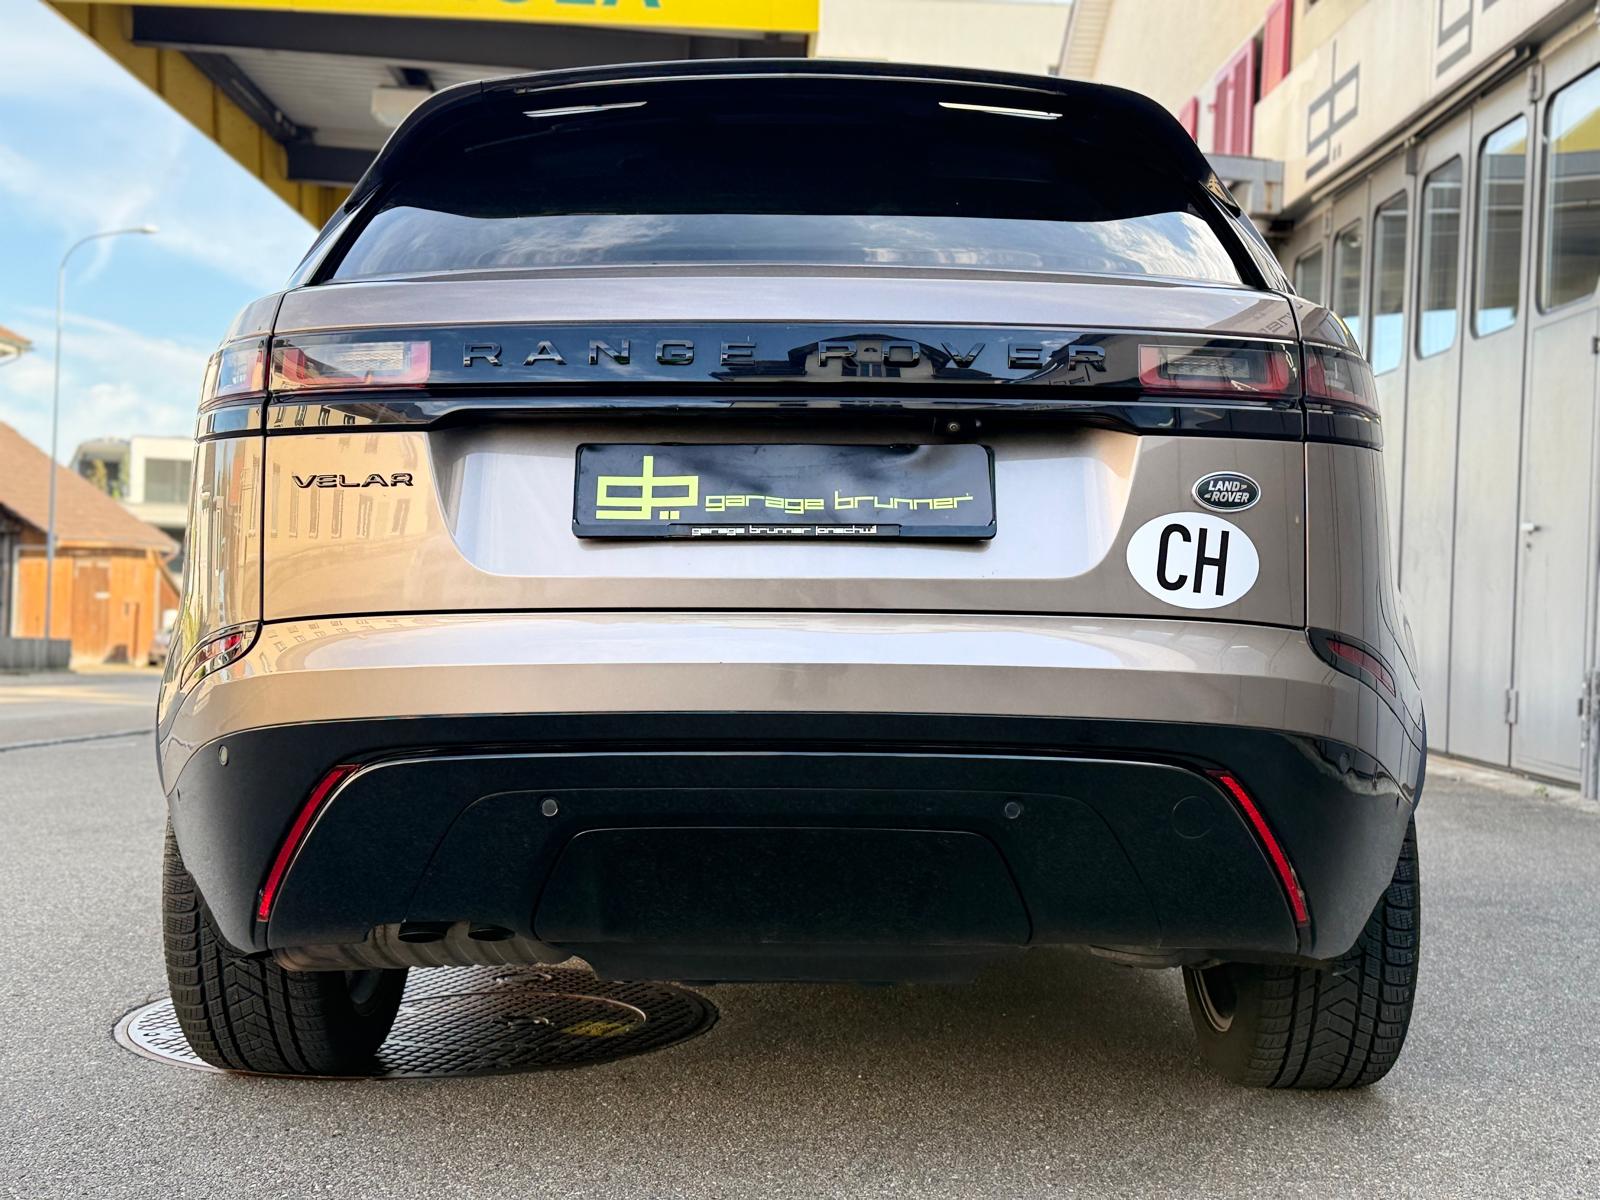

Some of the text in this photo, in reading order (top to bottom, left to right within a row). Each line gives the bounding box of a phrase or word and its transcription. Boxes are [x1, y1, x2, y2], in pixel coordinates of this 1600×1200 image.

[463, 339, 1106, 371] RANGE ROVER
[292, 473, 414, 488] VELAR
[1208, 480, 1240, 491] LAND
[705, 489, 973, 514] garage brunner
[1211, 492, 1249, 503] ROVER
[749, 525, 811, 535] brunner
[1156, 523, 1230, 596] CH
